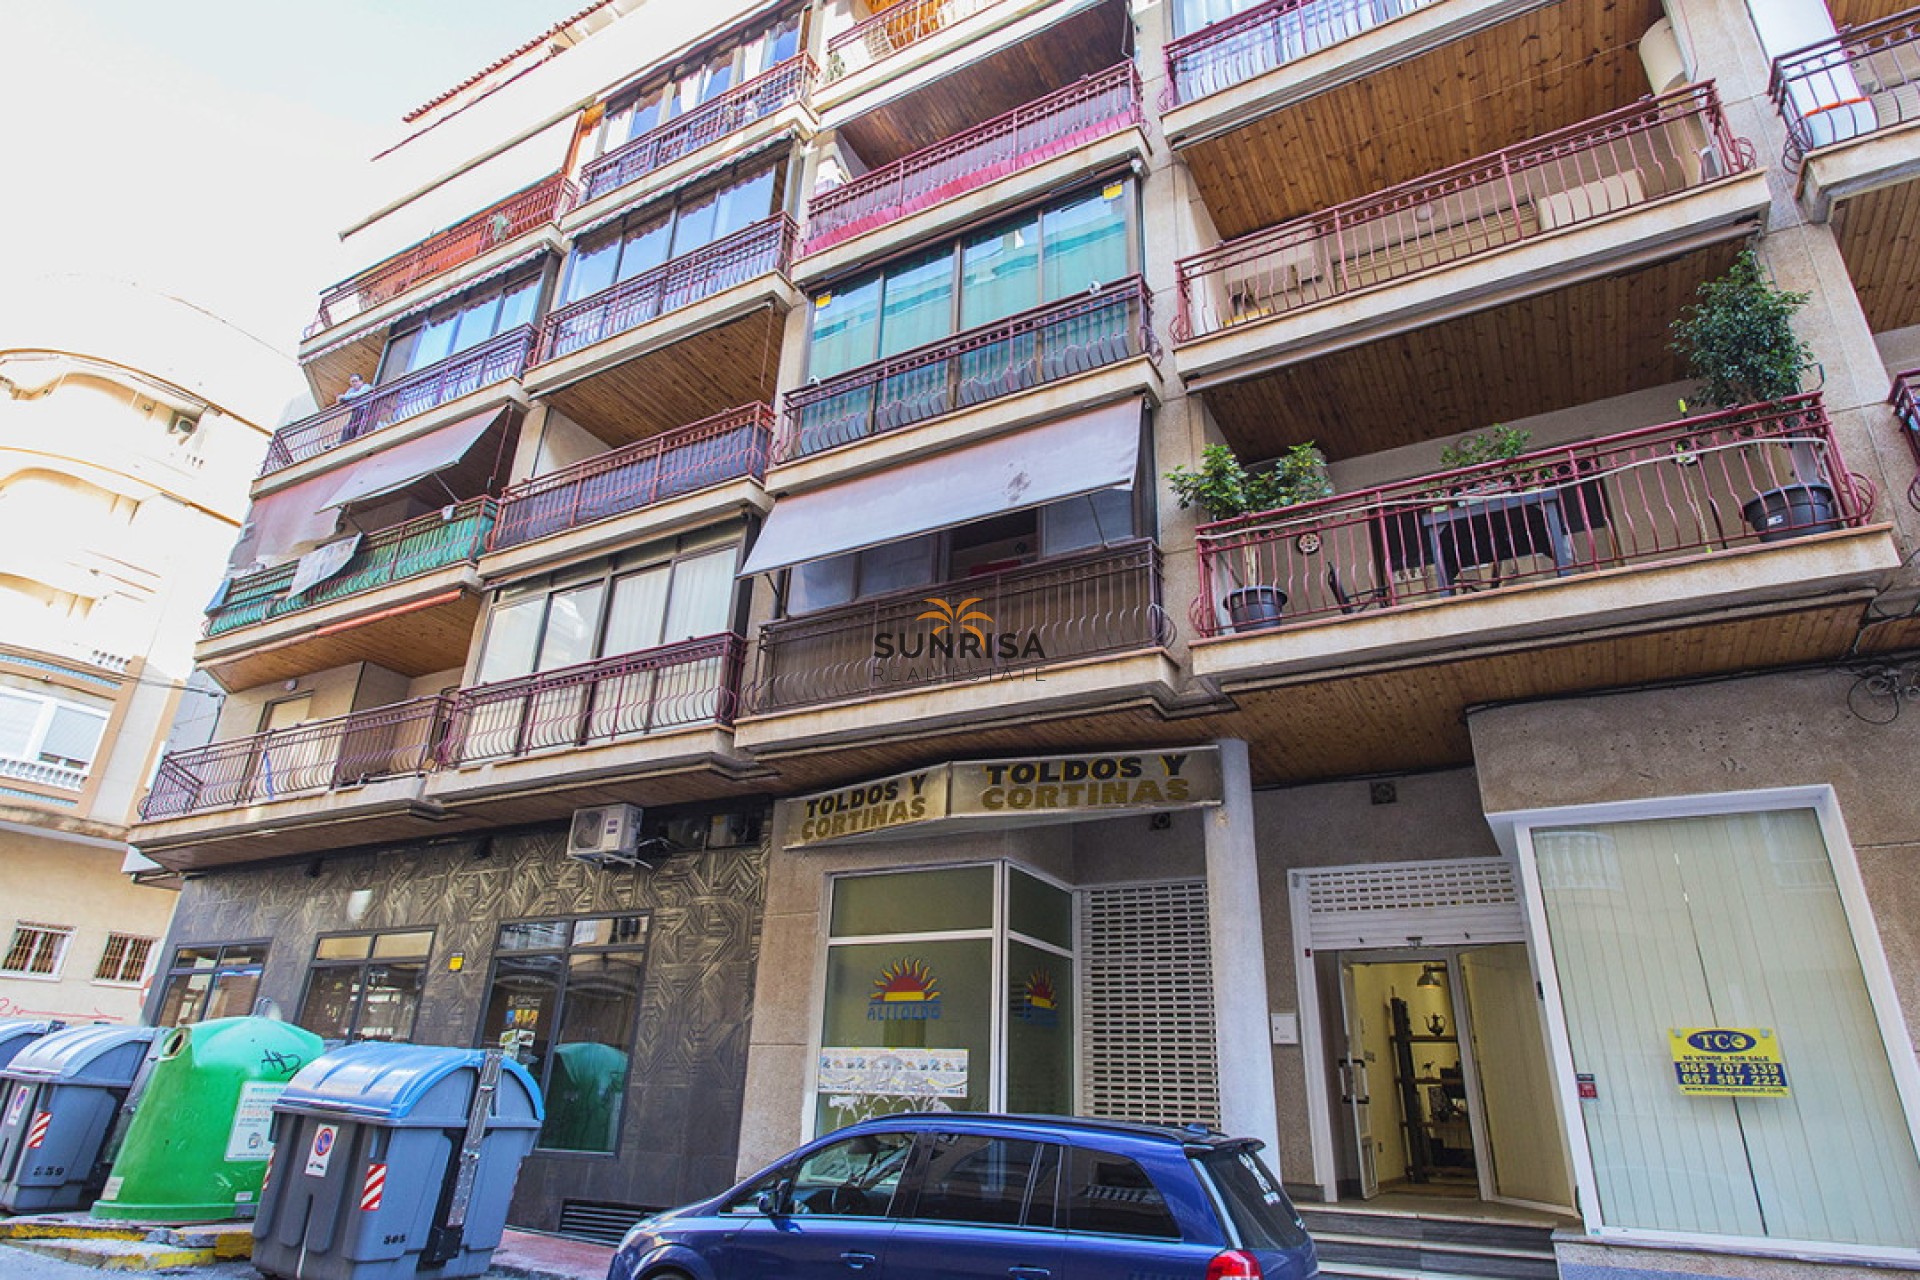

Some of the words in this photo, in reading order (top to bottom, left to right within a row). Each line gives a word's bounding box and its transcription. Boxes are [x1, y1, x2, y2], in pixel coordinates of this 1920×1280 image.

[982, 756, 1142, 785] TOLDOS
[1158, 753, 1188, 777] Y
[805, 780, 899, 818] TOLDOS
[909, 773, 929, 796] Y
[981, 778, 1190, 810] CORTINAS
[801, 797, 926, 840] CORTINAS
[1750, 1075, 1782, 1086] 222
